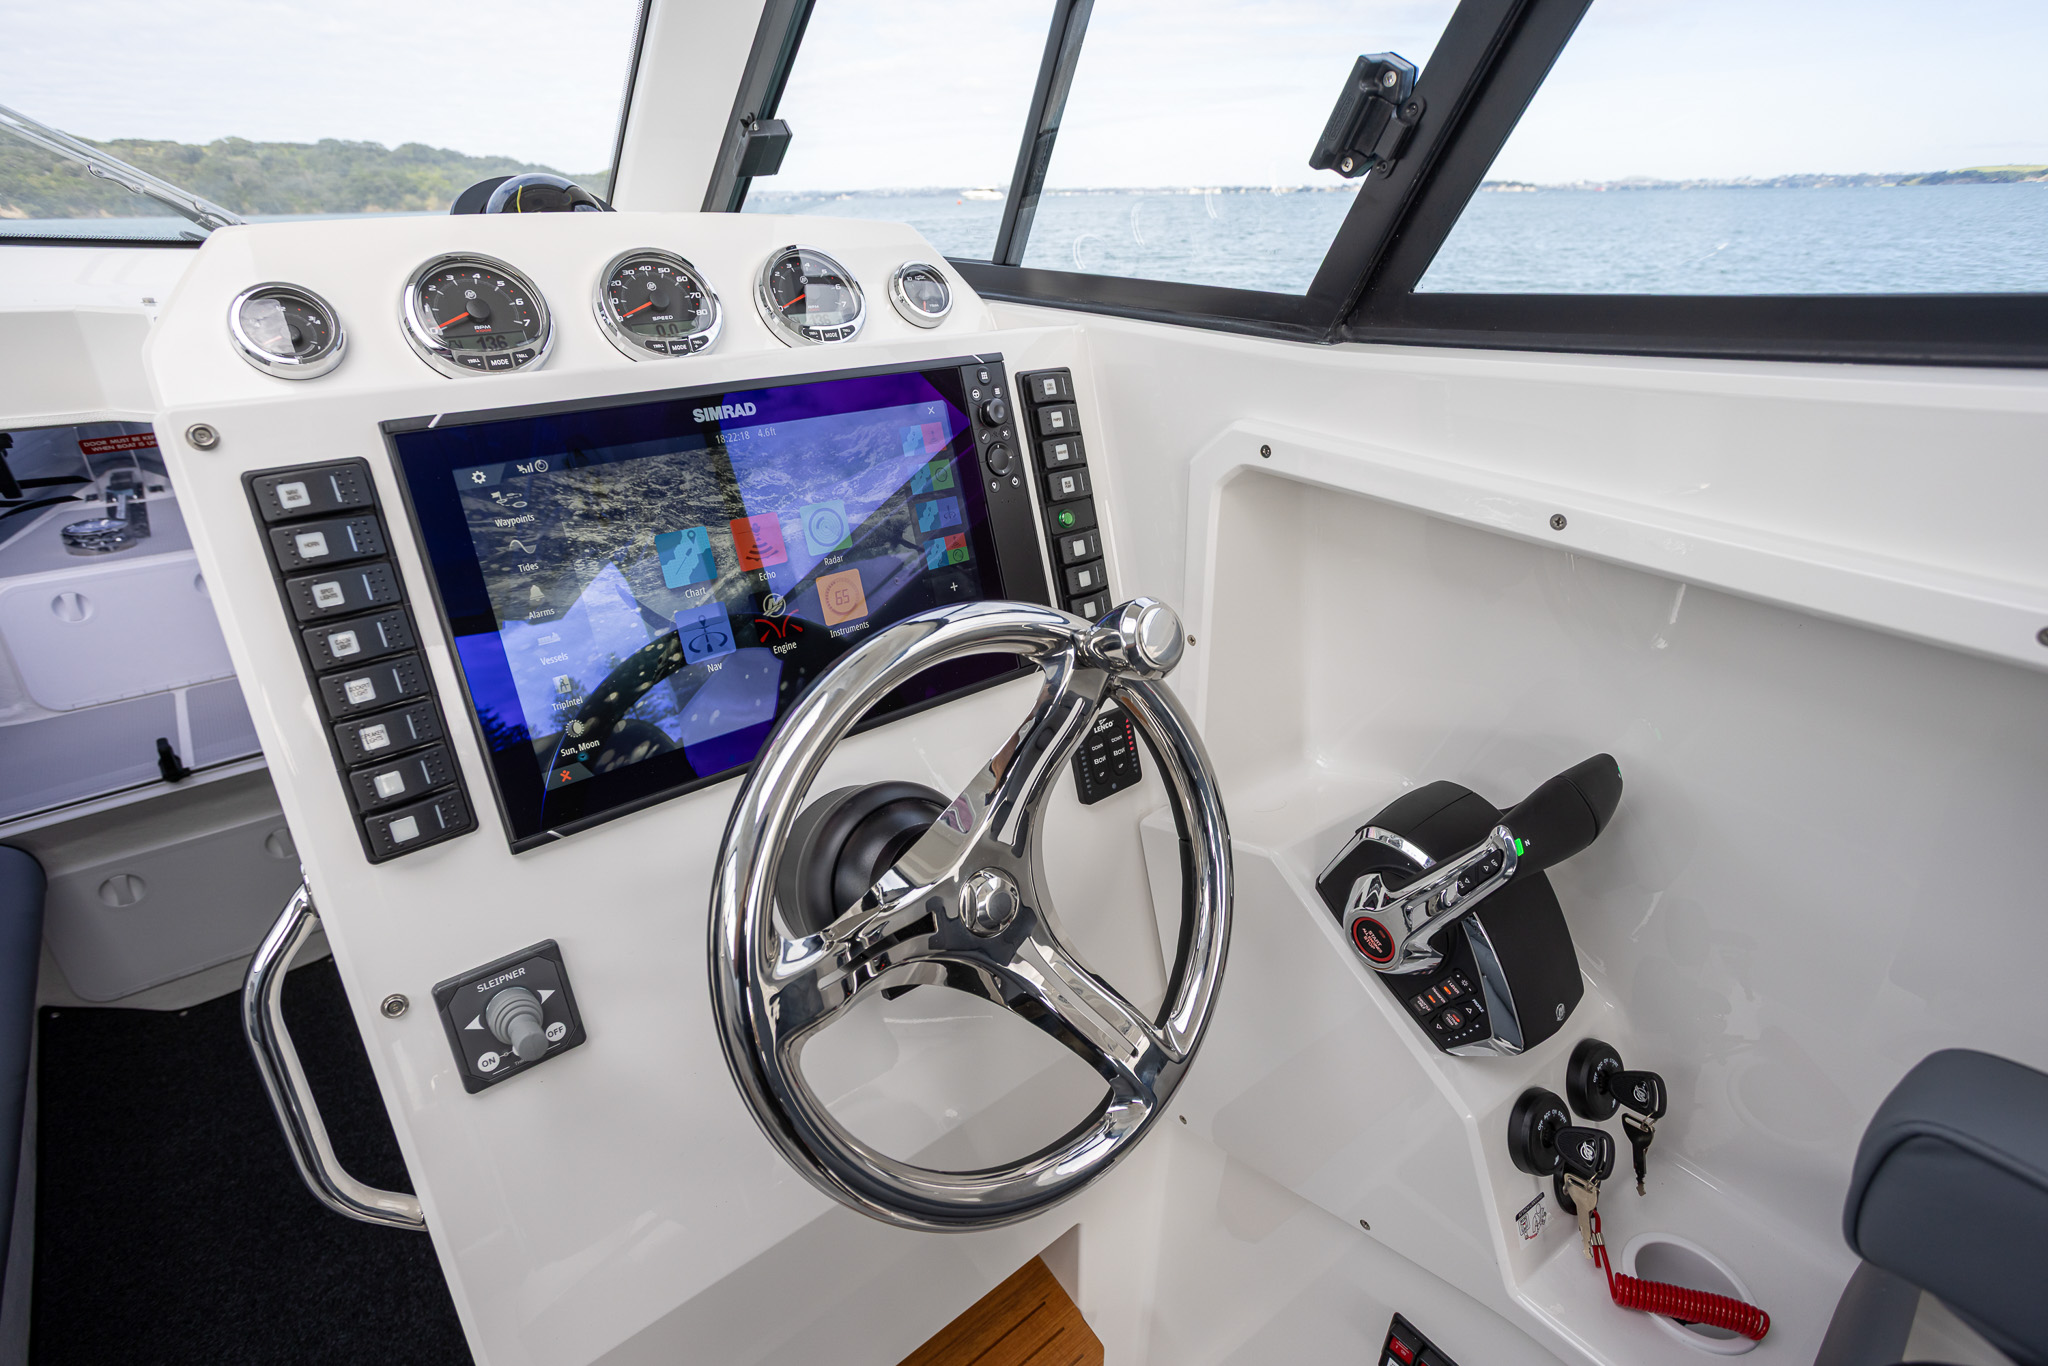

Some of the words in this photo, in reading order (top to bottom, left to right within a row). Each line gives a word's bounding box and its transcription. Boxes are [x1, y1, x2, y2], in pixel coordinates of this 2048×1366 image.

[692, 402, 756, 423] SIMRAD
[715, 431, 750, 444] 18:22:18
[758, 427, 776, 438] 4.6ft
[495, 514, 535, 528] Waypoints
[824, 555, 843, 566] Radar
[518, 562, 539, 573] Tides
[759, 571, 776, 581] Echo
[685, 587, 706, 599] Chart
[835, 588, 850, 605] 65
[528, 608, 555, 619] Alarms
[830, 621, 870, 638] Instruments
[773, 642, 797, 654] Engine
[540, 652, 568, 665] Vessels
[707, 662, 722, 673] Nav
[552, 696, 584, 711] TripIntel
[1094, 721, 1113, 733] LENCO
[560, 747, 578, 757] Sun,
[578, 740, 600, 751] Moon
[1094, 755, 1106, 764] BOW
[1364, 936, 1375, 949] STOP
[1368, 930, 1382, 946] START
[476, 967, 526, 993] SLEIPNER
[1449, 982, 1460, 994] LEVER
[1447, 1014, 1458, 1025] ACTIVE
[547, 1026, 563, 1038] OFF
[481, 1056, 496, 1068] ON
[1558, 1111, 1567, 1123] START
